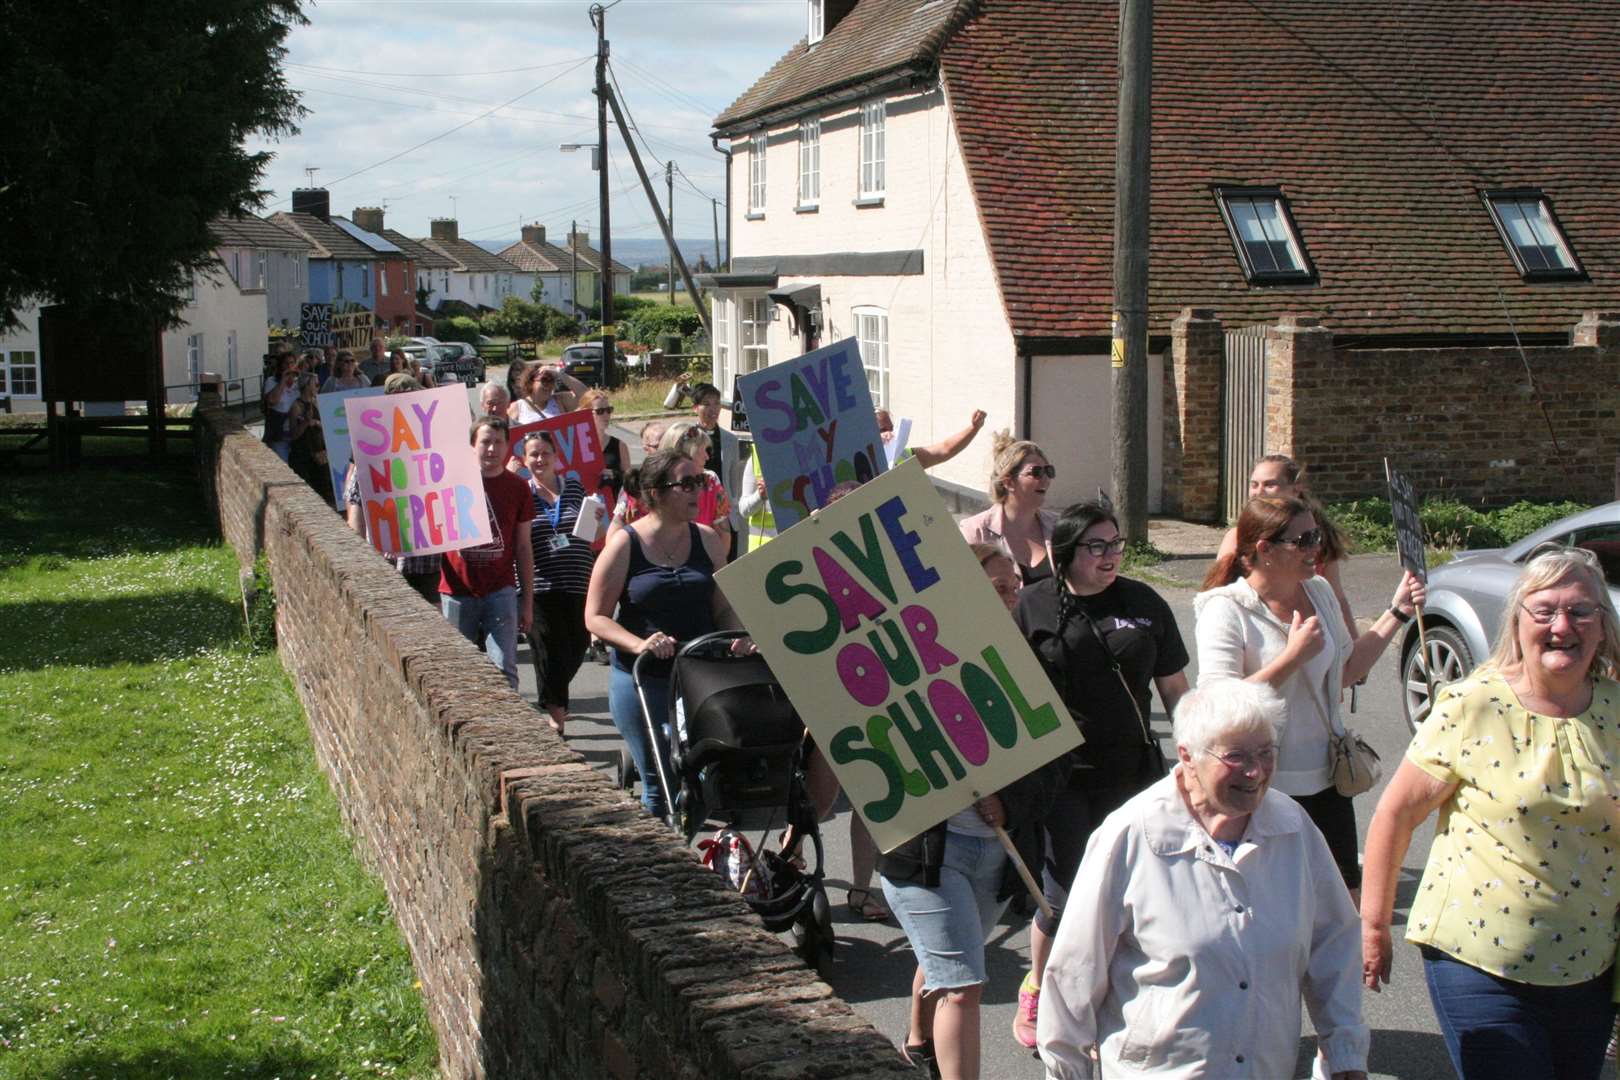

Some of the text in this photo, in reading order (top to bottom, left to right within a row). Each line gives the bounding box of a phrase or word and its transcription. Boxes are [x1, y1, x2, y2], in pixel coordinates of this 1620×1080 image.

[302, 304, 331, 321] SAVE
[306, 321, 329, 332] OUR
[356, 400, 439, 456] SAY
[755, 350, 857, 444] SAVE
[367, 456, 409, 494] NO
[412, 452, 445, 486] TO
[793, 418, 838, 471] MY
[366, 484, 481, 553] MERGER
[765, 495, 941, 655] SAVE
[836, 604, 960, 707] OUR
[830, 645, 1061, 824] SCHOOL
